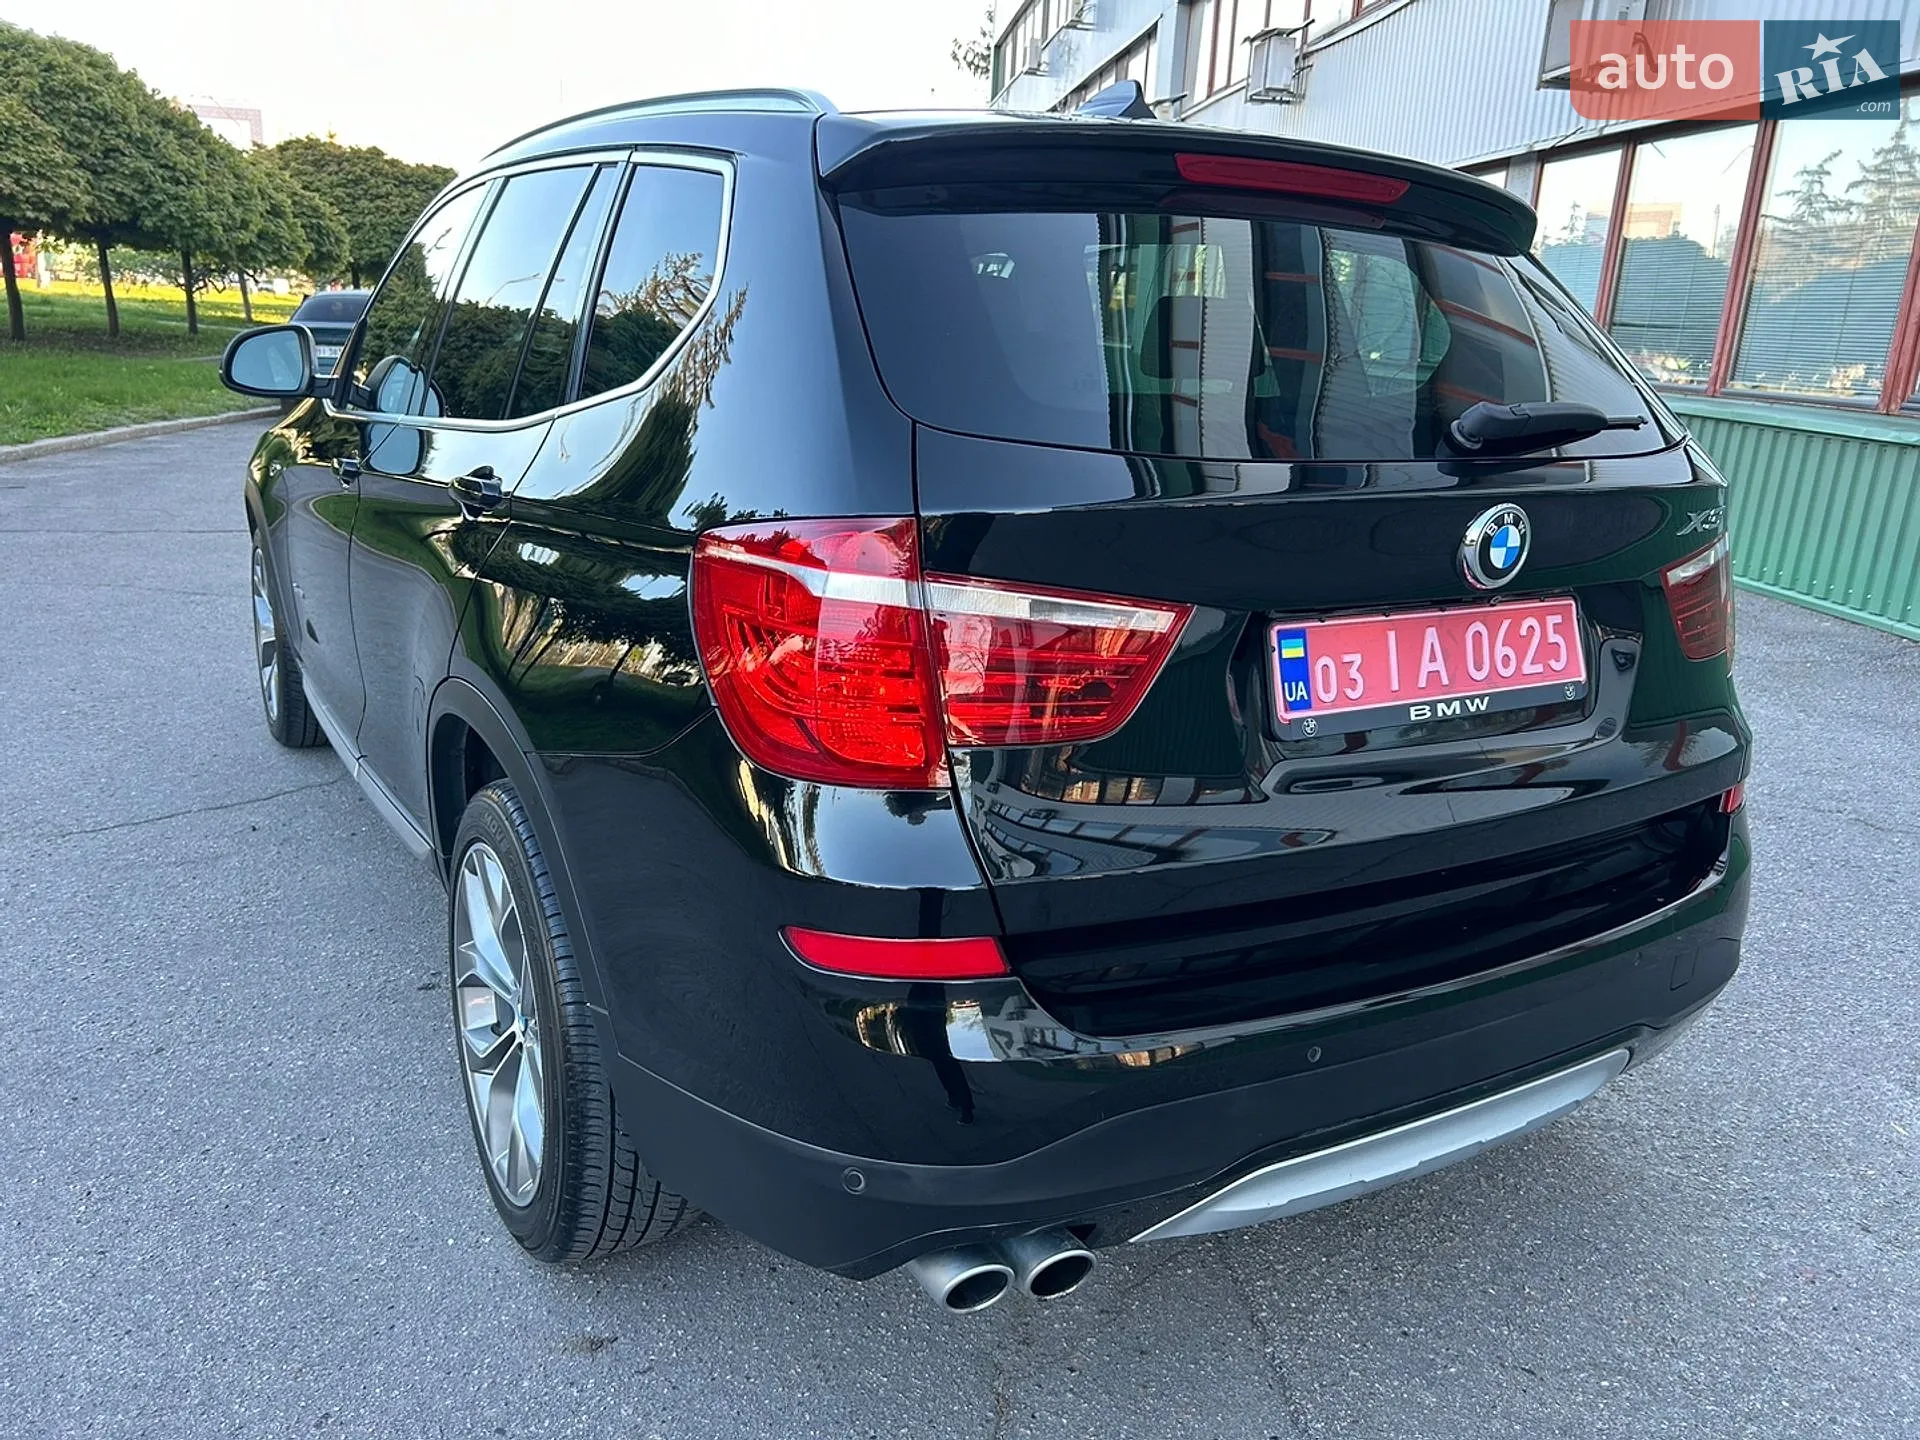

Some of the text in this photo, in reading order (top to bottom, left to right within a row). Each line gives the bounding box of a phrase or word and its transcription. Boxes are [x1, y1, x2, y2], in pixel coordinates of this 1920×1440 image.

[1486, 513, 1526, 537] BMW
[1314, 653, 1364, 703] 03
[1284, 681, 1308, 702] UA
[1409, 696, 1490, 720] BMW
